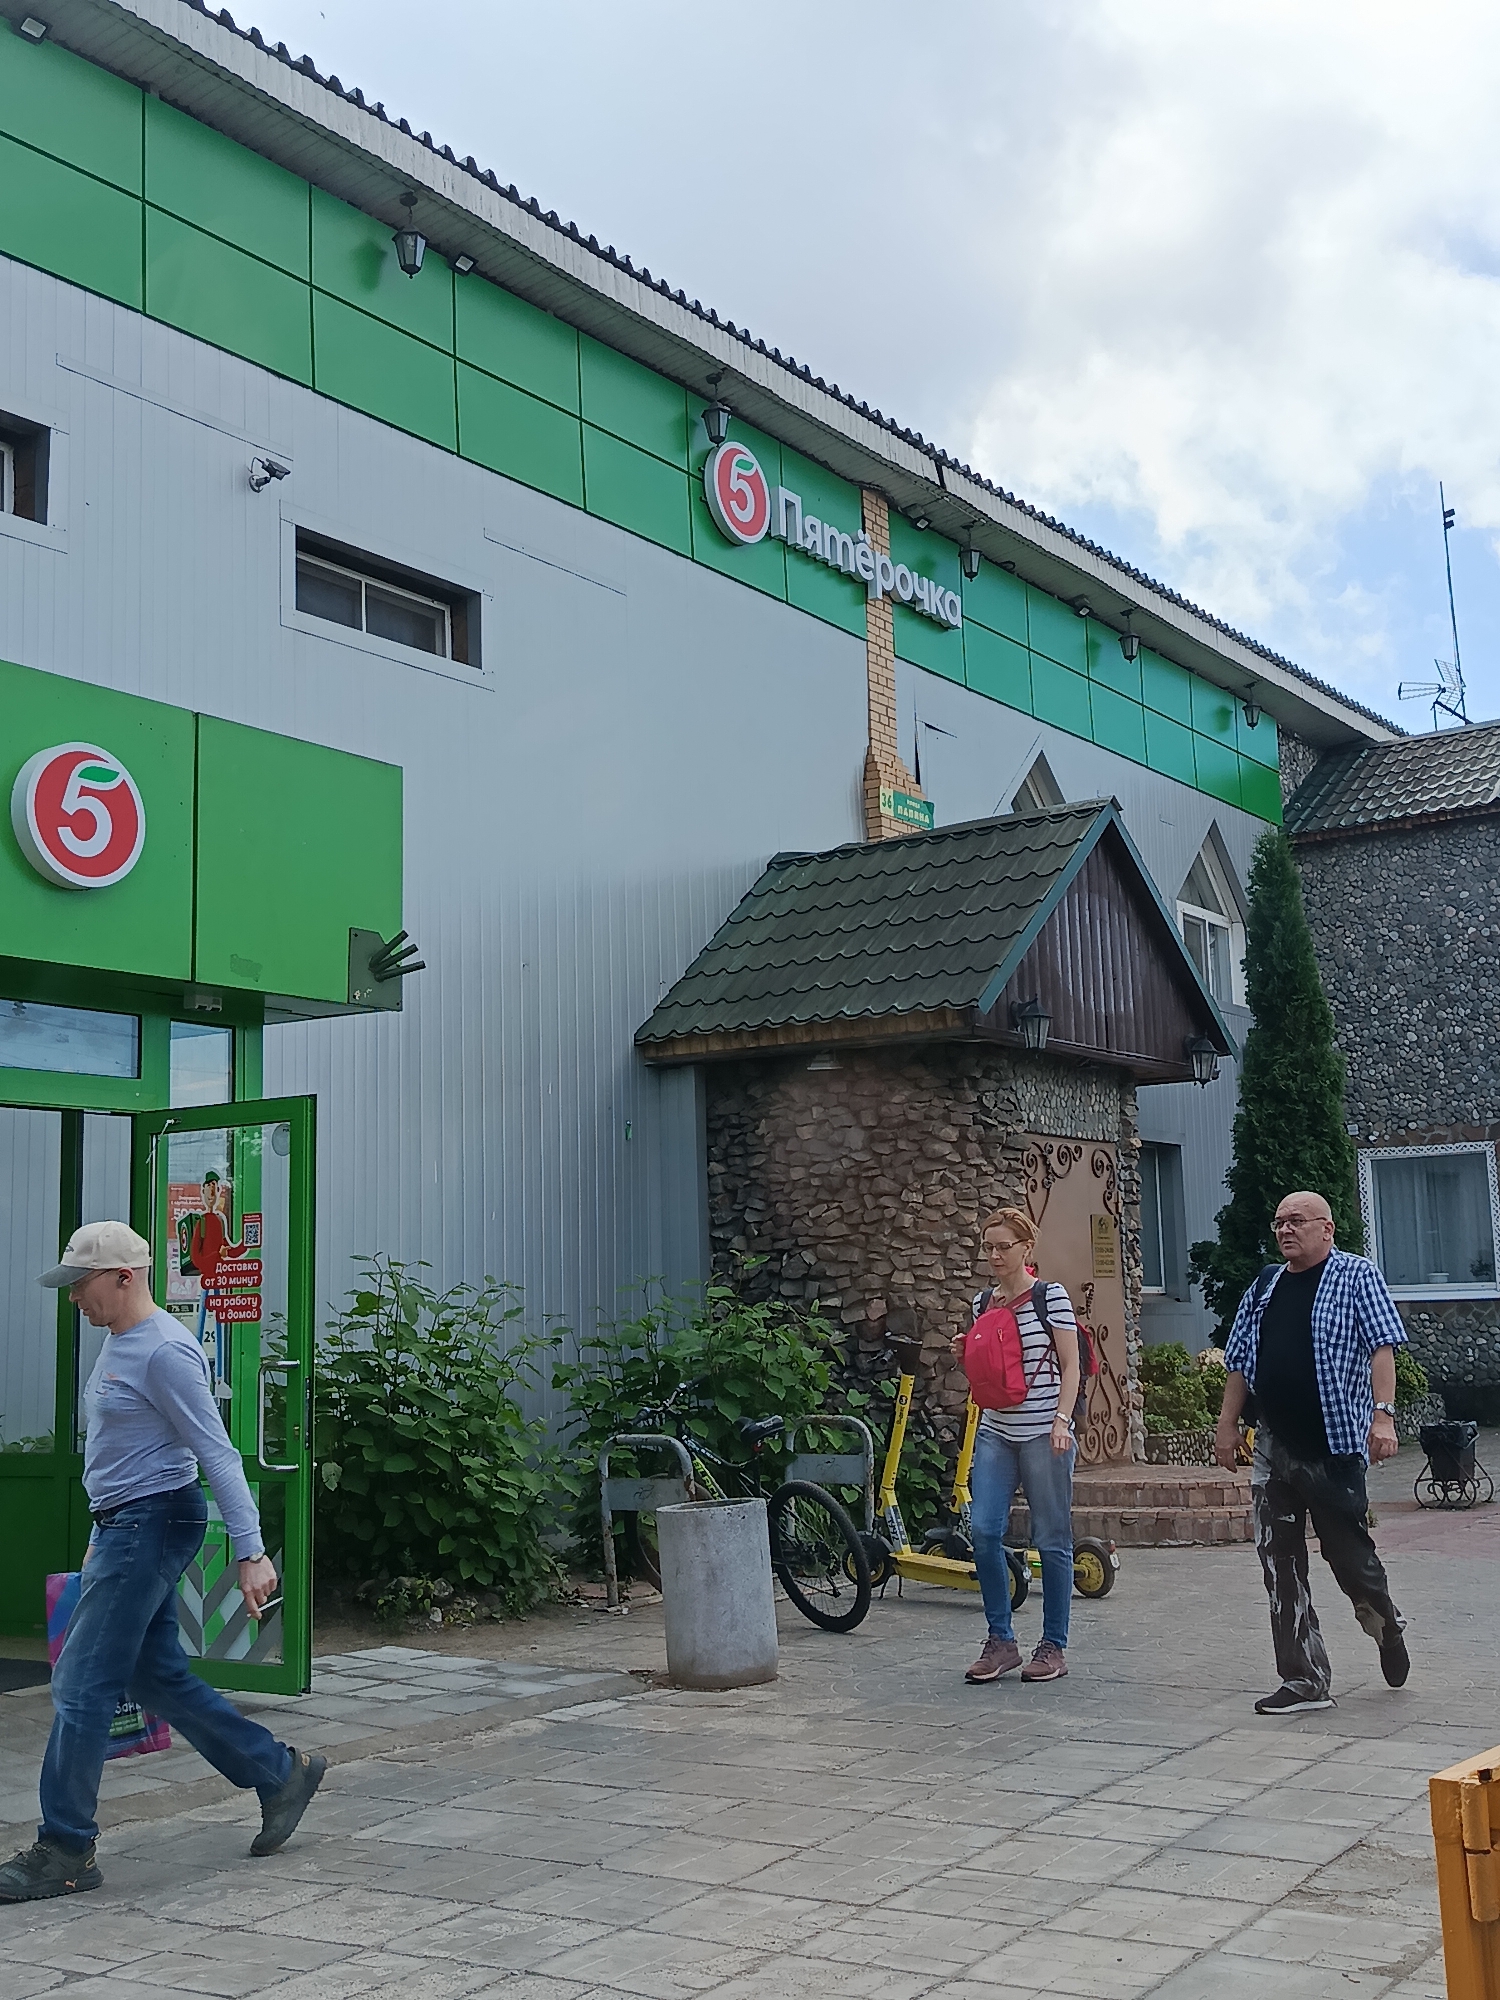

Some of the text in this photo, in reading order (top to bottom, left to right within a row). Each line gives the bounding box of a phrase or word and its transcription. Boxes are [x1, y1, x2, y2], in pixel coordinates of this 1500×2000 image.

[772, 485, 962, 629] Пятёрочка
[881, 792, 892, 809] 36
[57, 759, 122, 859] 5
[216, 1262, 258, 1273] Доставка
[205, 1276, 258, 1286] от 30 минут
[223, 1296, 258, 1308] работу
[227, 1309, 258, 1319] домой
